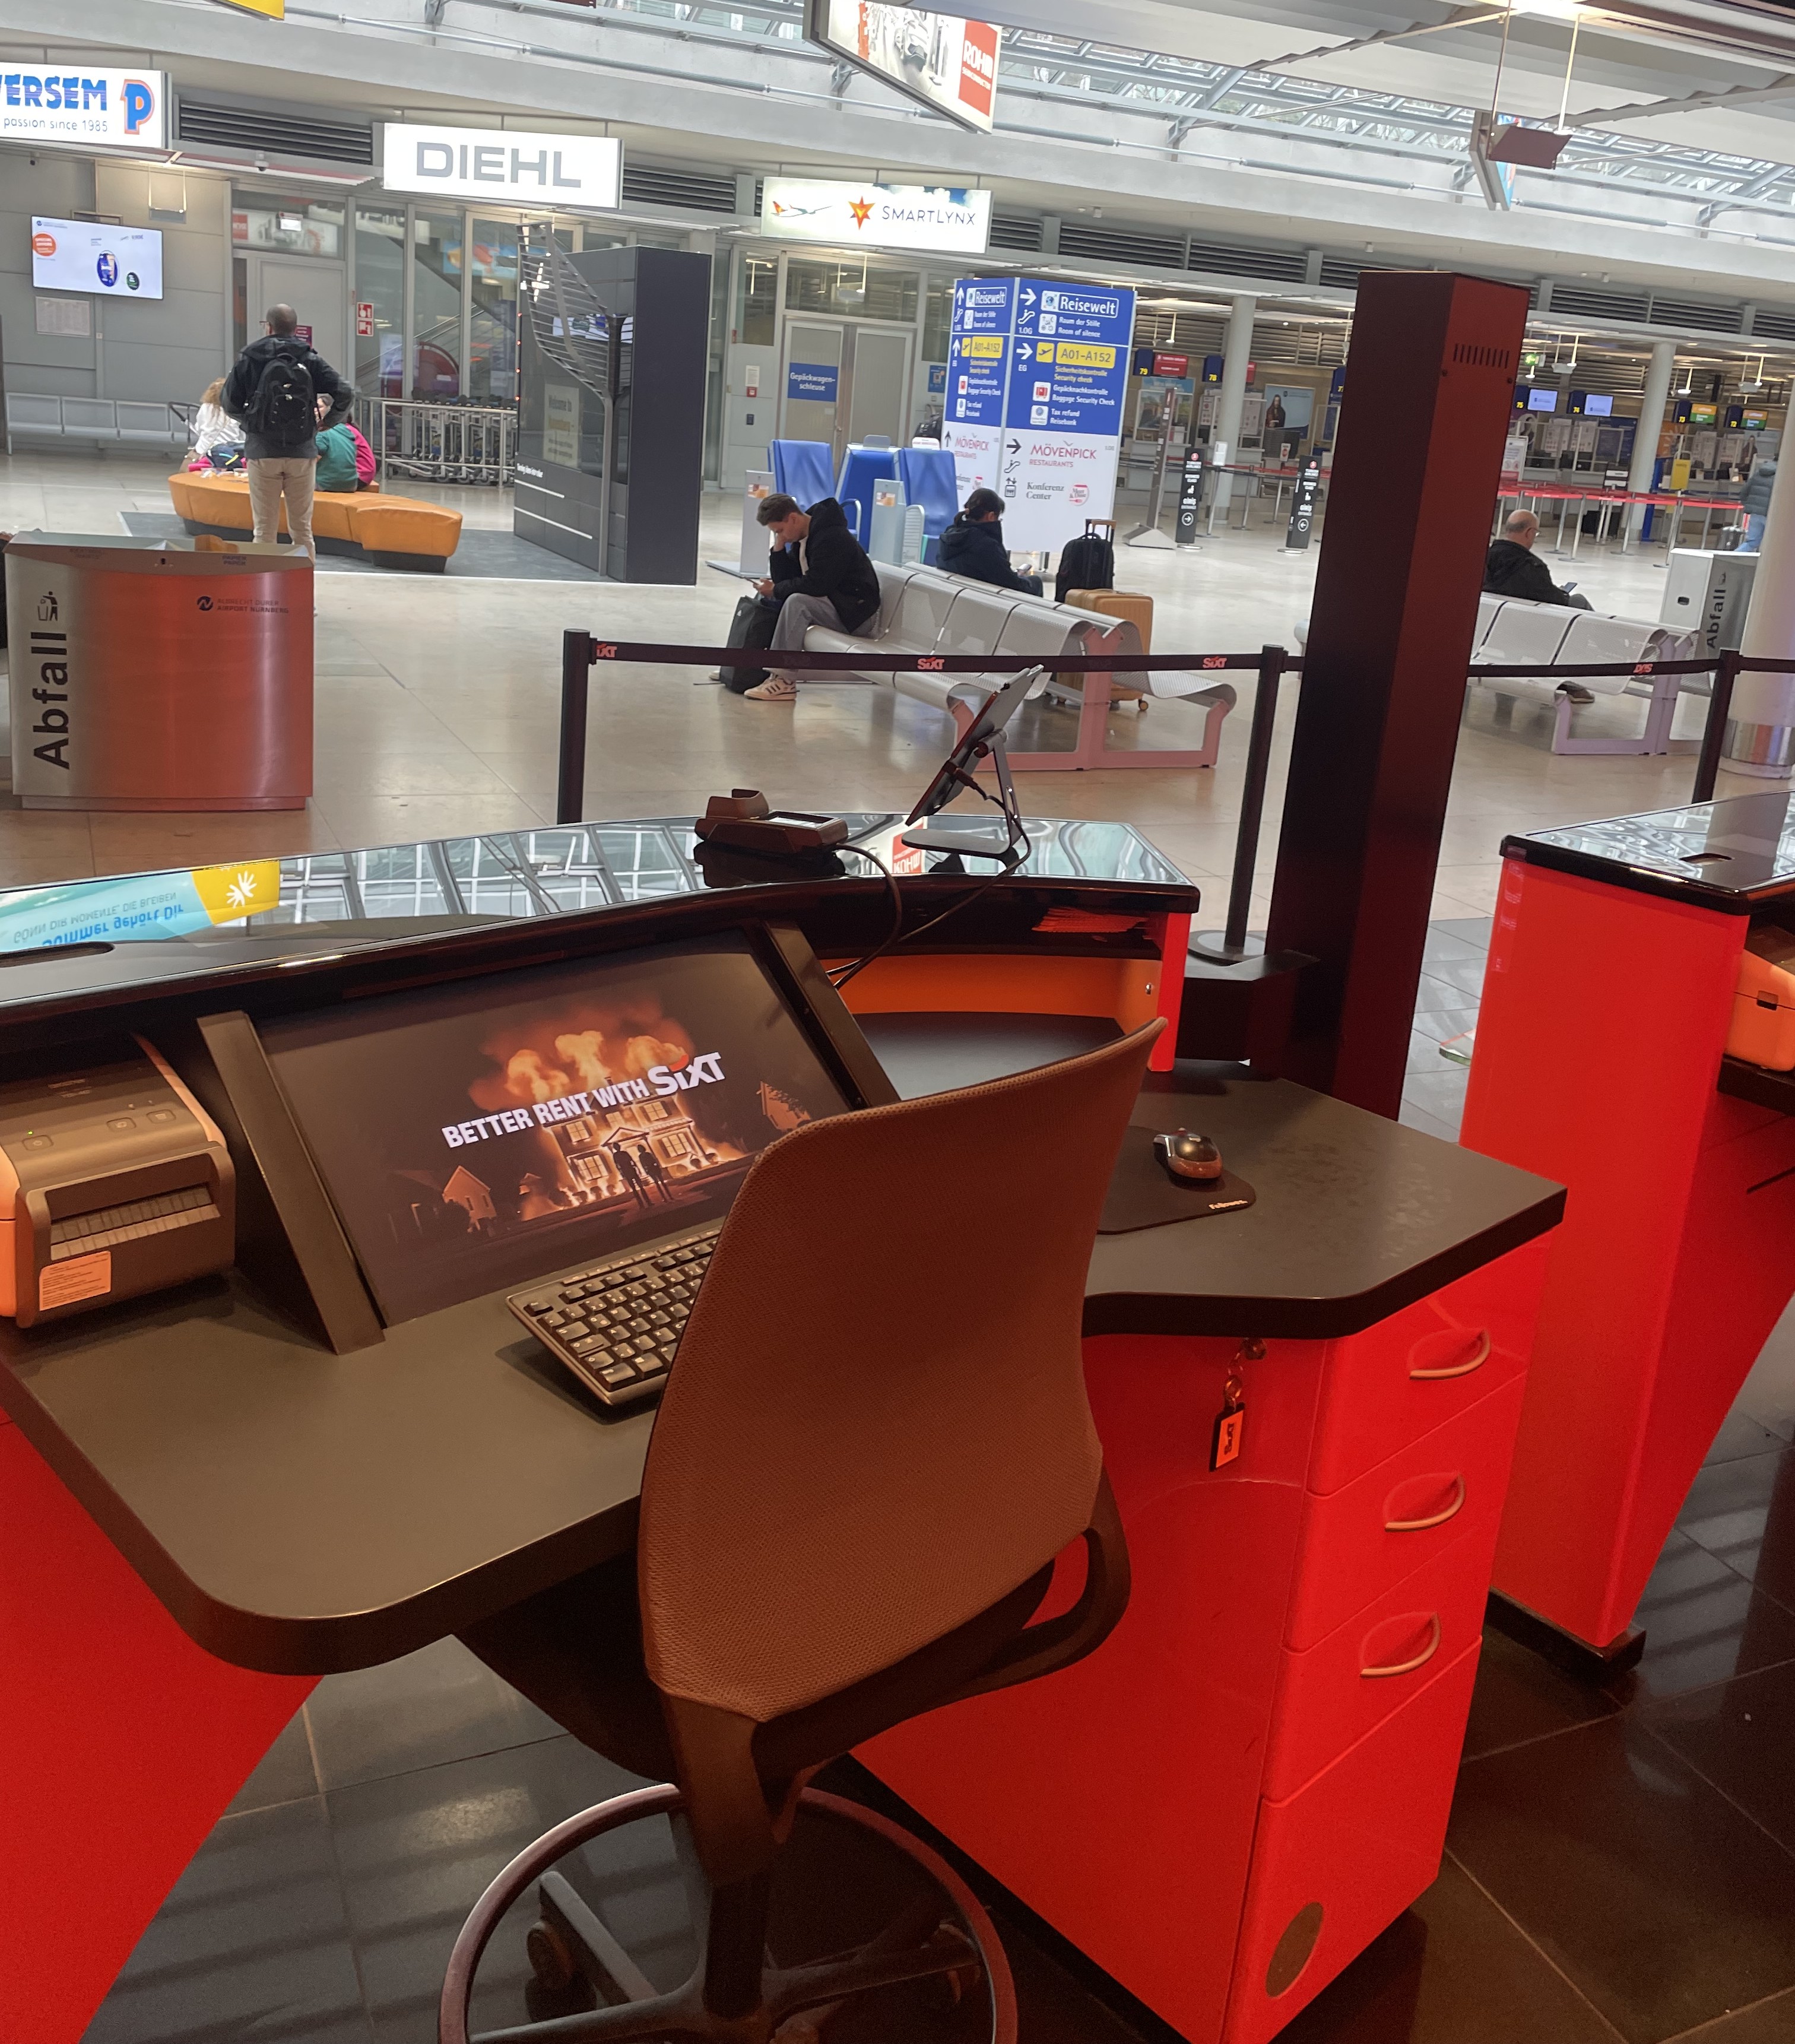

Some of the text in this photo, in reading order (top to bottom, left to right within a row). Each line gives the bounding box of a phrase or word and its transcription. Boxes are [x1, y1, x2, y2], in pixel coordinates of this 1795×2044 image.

[963, 40, 994, 79] ROHM
[0, 74, 107, 111] ERSEM
[4, 118, 108, 132] passion since 1985
[416, 141, 582, 189] DIEHL
[882, 205, 976, 226] SMARTLYNX
[1060, 296, 1116, 315] Reisewelt
[1061, 348, 1112, 363] A01-A152
[1030, 443, 1098, 459] MÖVENPICK
[1029, 458, 1074, 468] RESTAURANTS
[1026, 491, 1052, 500] Center
[1027, 482, 1064, 492] Konferenz
[1706, 589, 1726, 650] Abfall
[30, 632, 70, 770] Abfall
[441, 1108, 535, 1149] BETTER
[531, 1092, 592, 1125] RENT
[592, 1078, 651, 1109] WITH
